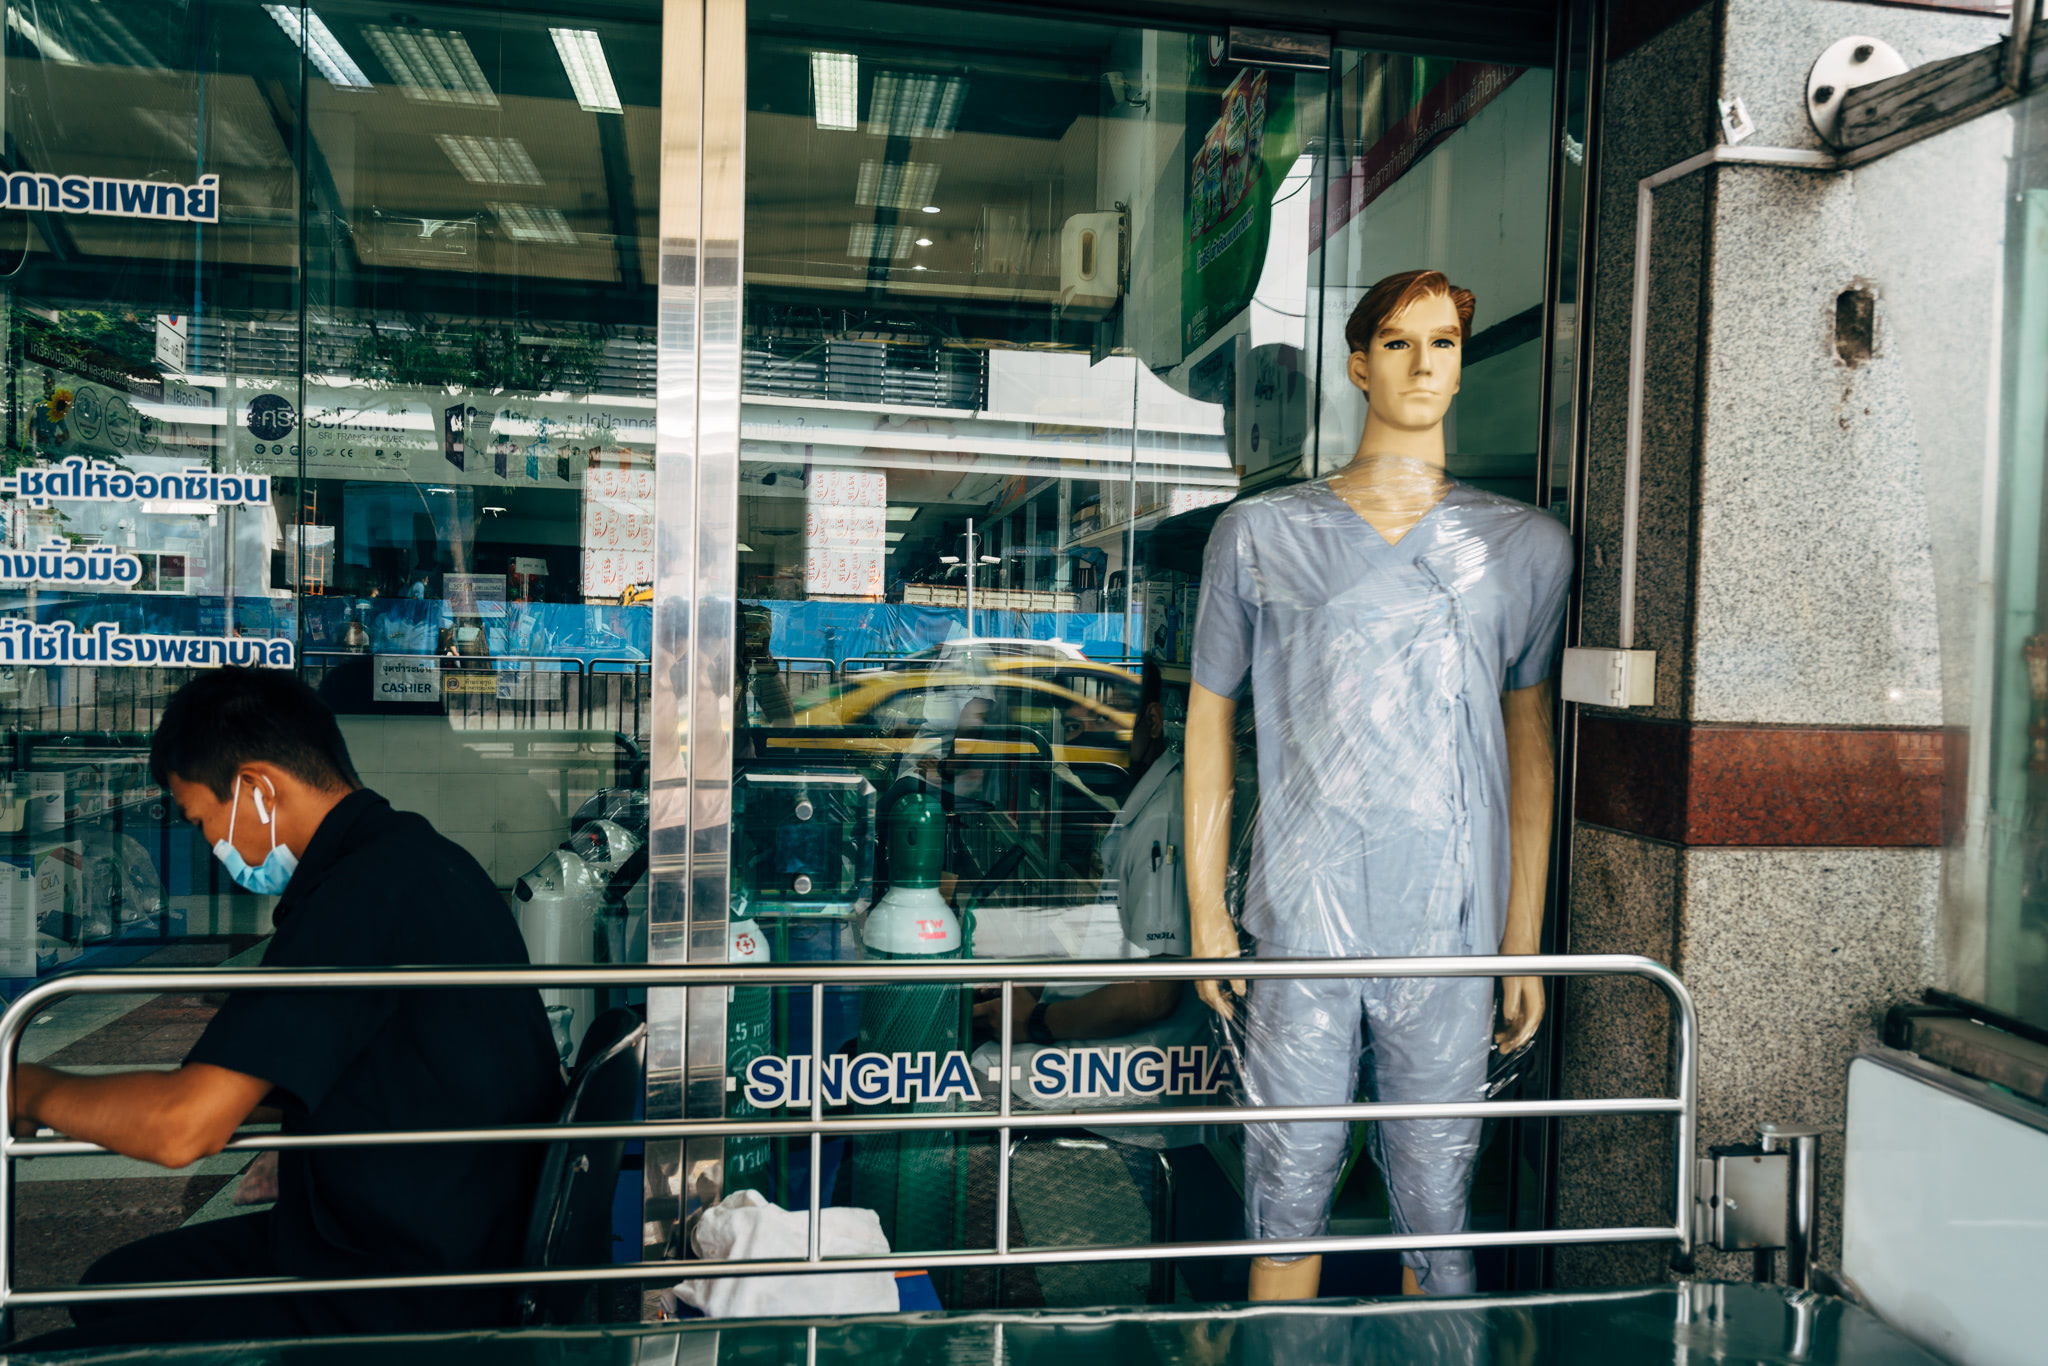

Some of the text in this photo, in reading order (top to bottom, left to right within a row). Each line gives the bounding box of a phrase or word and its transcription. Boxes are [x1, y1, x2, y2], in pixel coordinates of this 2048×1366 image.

[0, 173, 217, 220] การแพทย์
[381, 682, 432, 693] CASHIER
[1146, 931, 1176, 941] SINGHA
[748, 1049, 1238, 1104] SINGHA SINGHA
